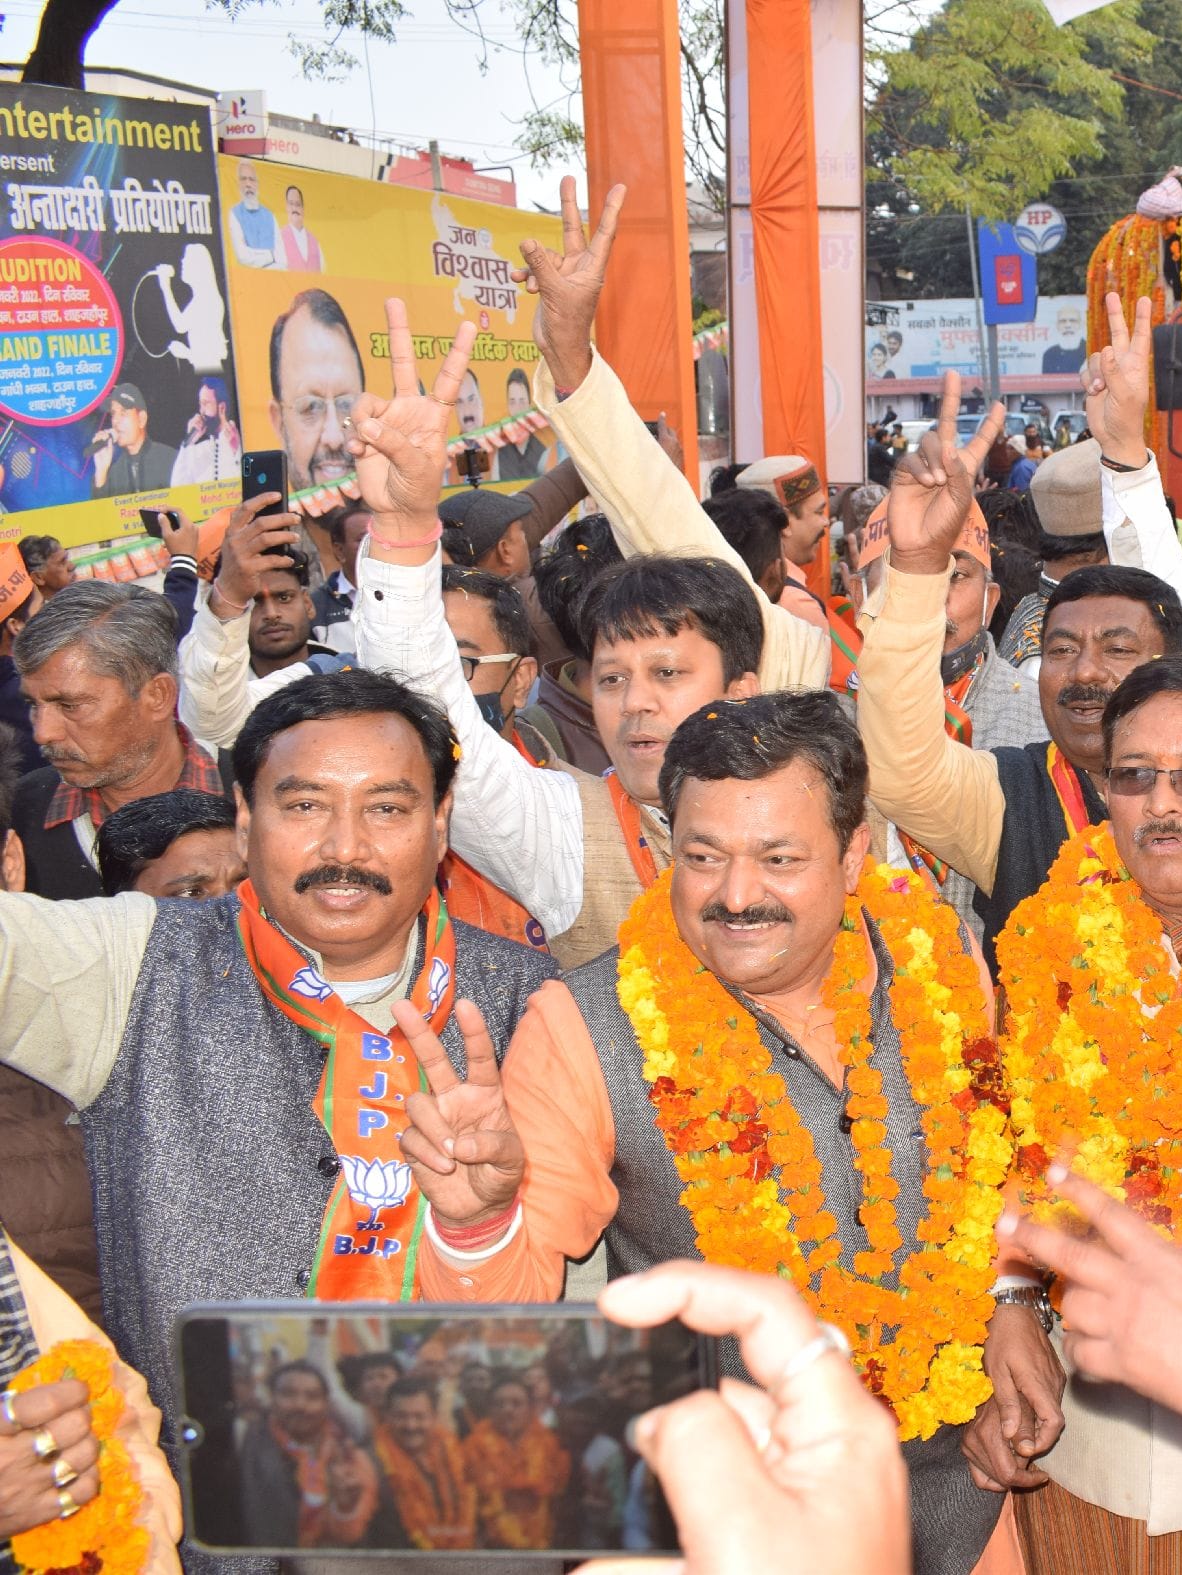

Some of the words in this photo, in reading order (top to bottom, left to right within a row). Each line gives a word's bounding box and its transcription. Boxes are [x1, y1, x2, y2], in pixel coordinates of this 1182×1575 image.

[225, 124, 256, 135] Hero
[110, 177, 213, 235] प्रतियोगिता
[1027, 210, 1052, 226] HP
[448, 225, 476, 247] जन
[0, 258, 82, 282] UDITION
[433, 242, 509, 285] विश्वास
[475, 286, 517, 310] यात्रा
[46, 333, 112, 358] FINALE
[333, 1234, 401, 1260] B.J.P
